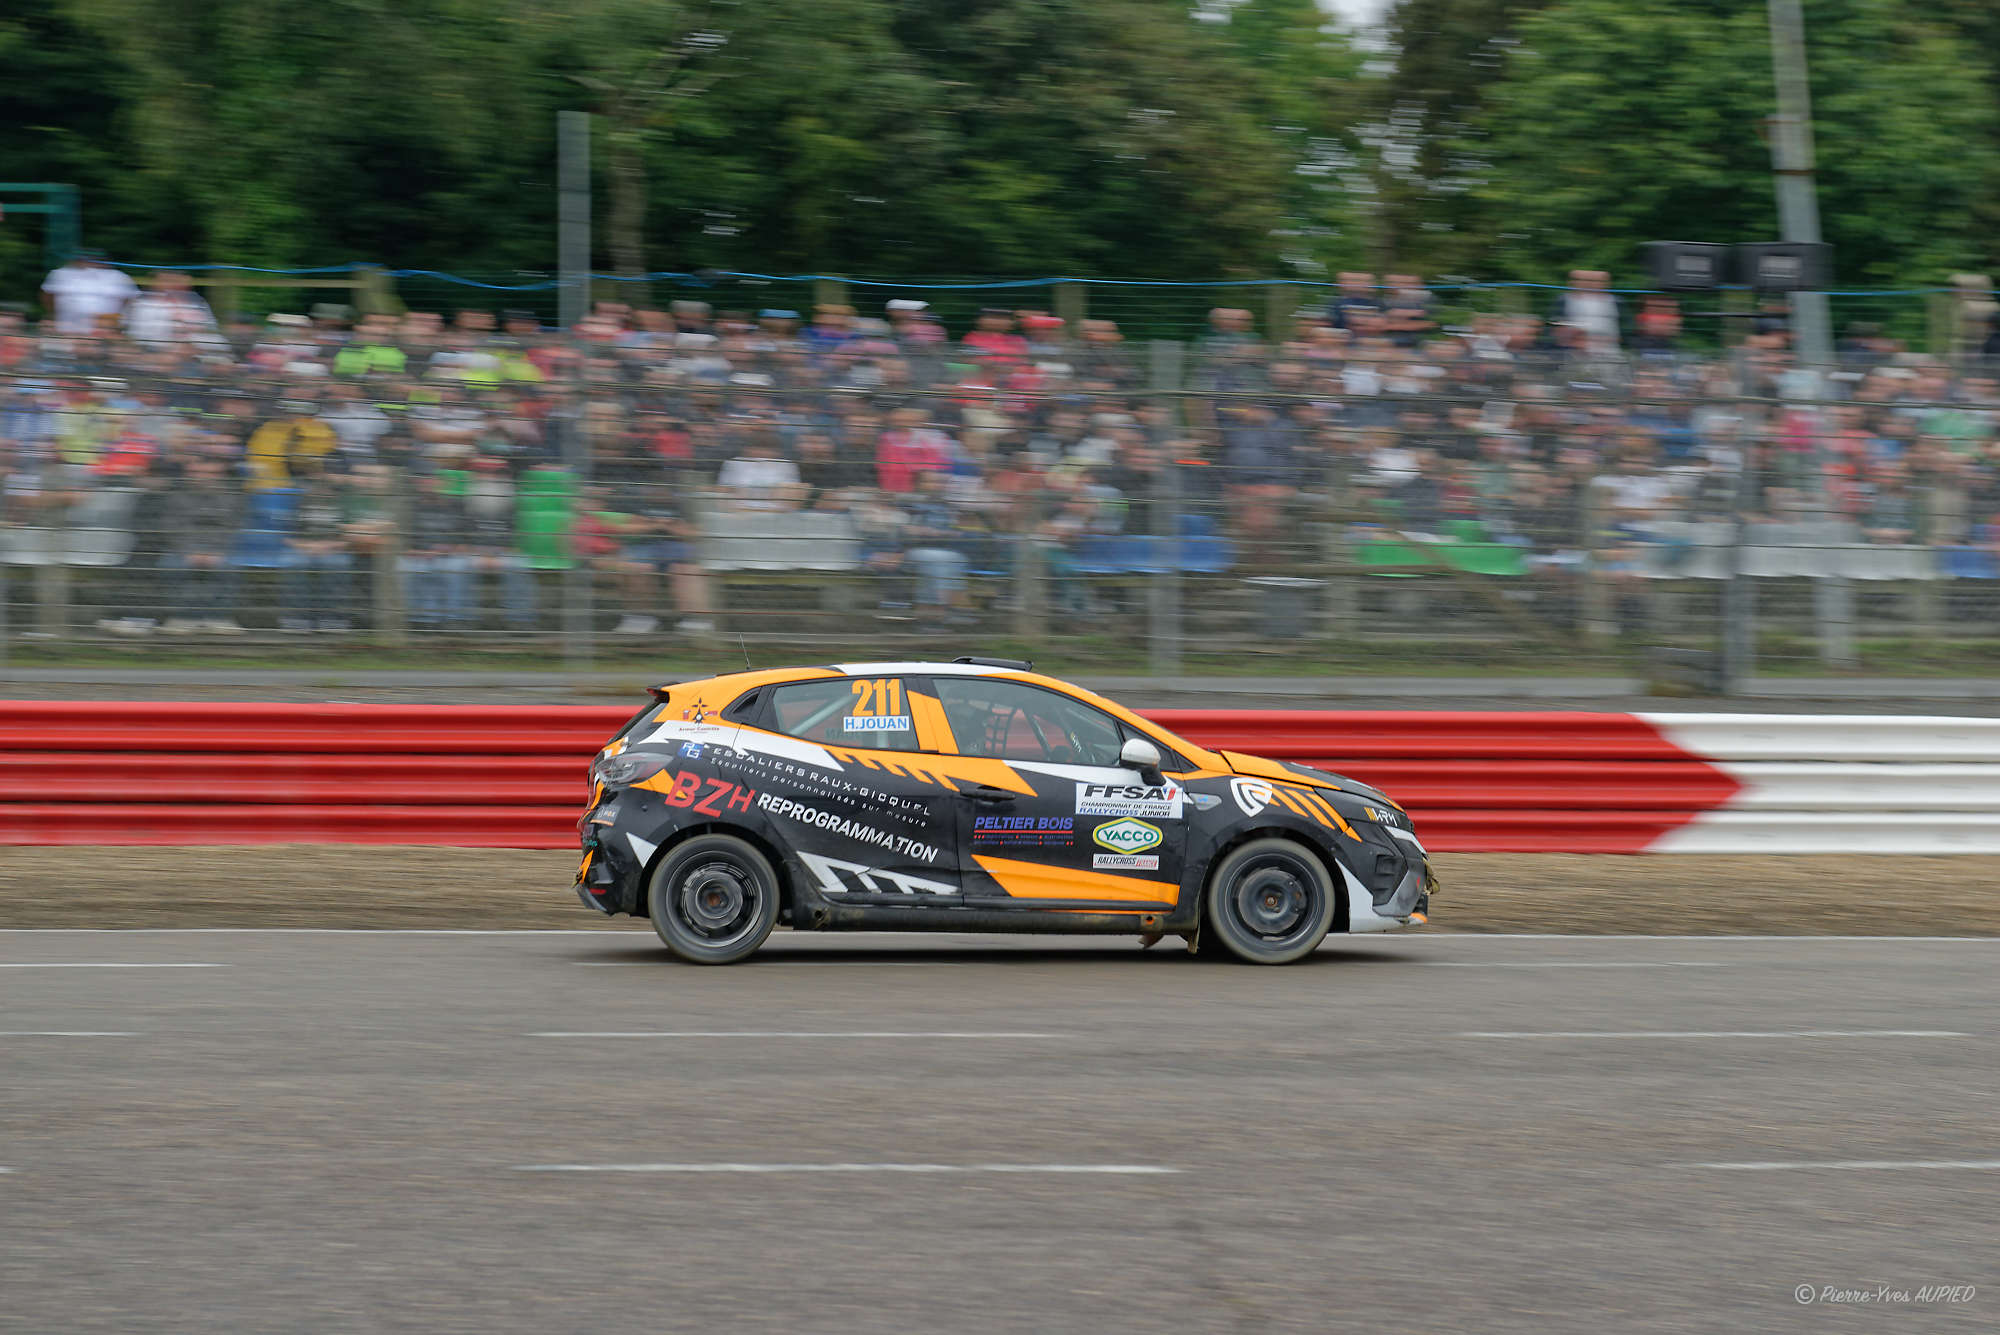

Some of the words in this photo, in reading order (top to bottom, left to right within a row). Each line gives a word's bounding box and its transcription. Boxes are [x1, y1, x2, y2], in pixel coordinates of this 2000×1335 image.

[852, 678, 900, 716] 211
[845, 718, 907, 730] H.JOUAN
[664, 770, 757, 818] BZH
[1085, 785, 1165, 800] FFSA
[1079, 807, 1138, 816] RALLYCROSS
[1139, 809, 1171, 817] JUNIOR
[1081, 801, 1132, 810] CHAMPIONNAT
[1133, 802, 1143, 810] DE
[1144, 803, 1172, 811] FRANCE
[861, 803, 880, 812] sur
[886, 809, 927, 828] mesure
[757, 792, 939, 863] REPROGRAMMATION
[974, 816, 1035, 829] PELTIER
[1037, 816, 1074, 830] BOIS
[1103, 830, 1154, 842] YACCO
[1097, 855, 1137, 865] RALLYCROSS
